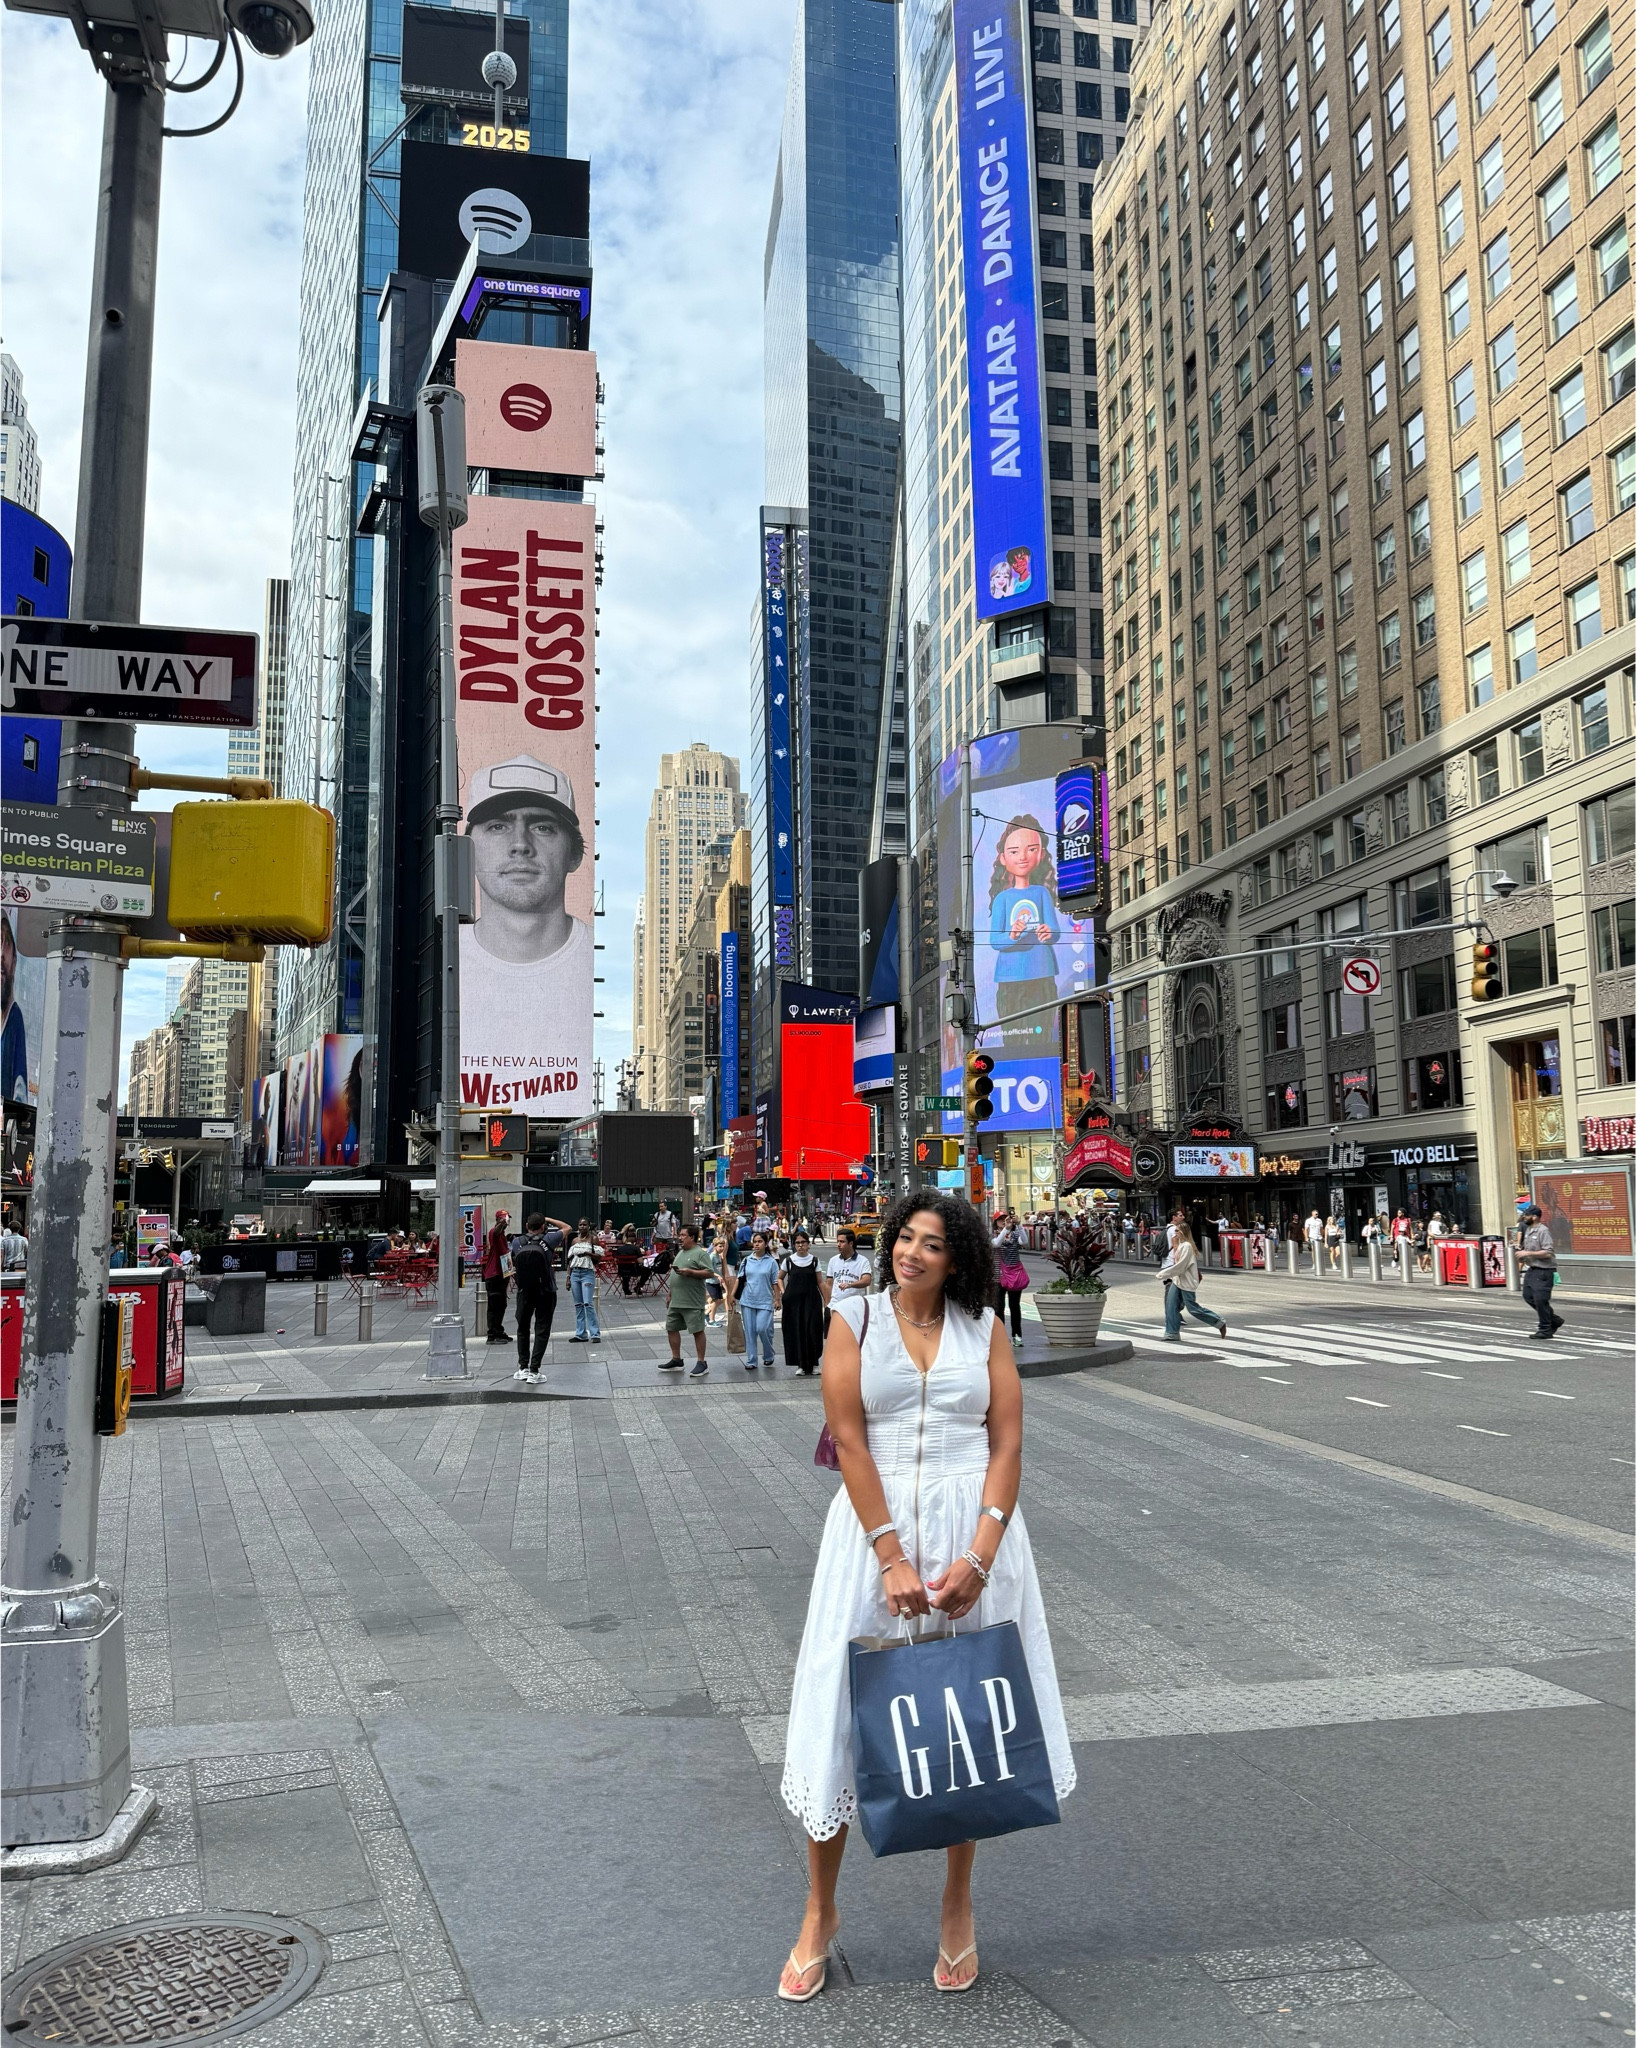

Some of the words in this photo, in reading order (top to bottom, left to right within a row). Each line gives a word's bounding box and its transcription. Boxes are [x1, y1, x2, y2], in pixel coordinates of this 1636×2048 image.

[973, 18, 1005, 110] LIVE
[463, 124, 530, 151] 2025
[978, 136, 1013, 286] DANCE
[484, 279, 506, 290] one
[507, 280, 539, 293] times
[541, 284, 581, 298] square
[986, 318, 1022, 477] AVATAR
[460, 547, 519, 703] DYLAN
[525, 529, 584, 730] GOSSETT
[1, 648, 69, 687] NE
[117, 655, 214, 695] WAY
[168, 713, 241, 723] TRANSPORTATION
[1, 806, 14, 814] EN
[16, 808, 27, 816] TO
[29, 809, 59, 819] PUBLIC
[125, 820, 148, 830] NYC
[55, 833, 127, 855] Square
[1061, 834, 1090, 850] TACO
[1, 850, 92, 872] edestrian
[96, 858, 145, 878] Plaza
[1063, 846, 1091, 861] BELL
[774, 909, 793, 965] ROKU
[724, 942, 736, 998] blooming.
[804, 1007, 851, 1017] LAWFTY
[462, 1056, 489, 1067] THE
[492, 1056, 526, 1067] NEW
[529, 1056, 578, 1068] ALBUM
[899, 1064, 909, 1119] SQUARE
[926, 1098, 935, 1109] W
[938, 1098, 951, 1109] 44
[1191, 1128, 1211, 1137] Hard
[1211, 1128, 1230, 1139] Rock
[1585, 1115, 1635, 1152] BUBB
[1178, 1157, 1207, 1165] SHINE
[1259, 1156, 1279, 1176] Rock
[1279, 1154, 1301, 1175] Shop
[1328, 1140, 1366, 1170] Lids
[1391, 1147, 1424, 1166] TACO
[1426, 1144, 1460, 1163] BELL
[1572, 1217, 1600, 1225] BUENA
[1601, 1216, 1628, 1226] VISTA
[1573, 1227, 1600, 1236] SOCIAL
[1602, 1227, 1629, 1236] CLUB
[890, 1676, 1017, 1800] GAP
